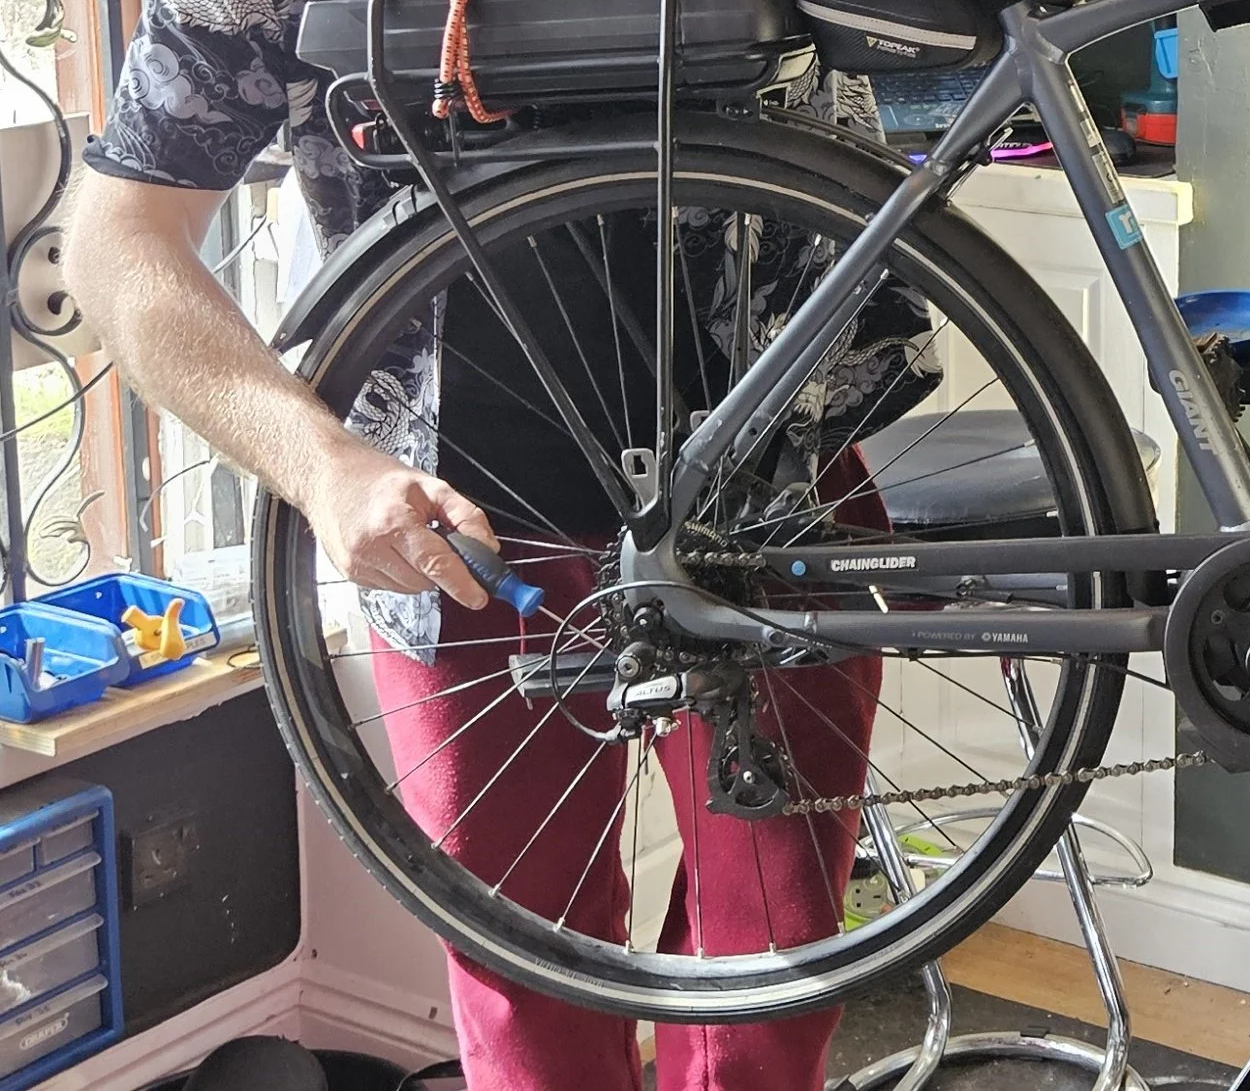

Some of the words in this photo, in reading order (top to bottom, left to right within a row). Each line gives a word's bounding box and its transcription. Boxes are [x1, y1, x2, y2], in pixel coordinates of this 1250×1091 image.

[878, 38, 916, 54] TOPEAK
[1169, 370, 1218, 455] GIANT
[684, 520, 729, 548] SHIMANO
[830, 556, 916, 572] CHAINGLIDER
[917, 631, 962, 640] POWERED
[963, 632, 976, 641] BY
[992, 632, 1029, 643] YAMAHA
[635, 685, 672, 697] ALTUS
